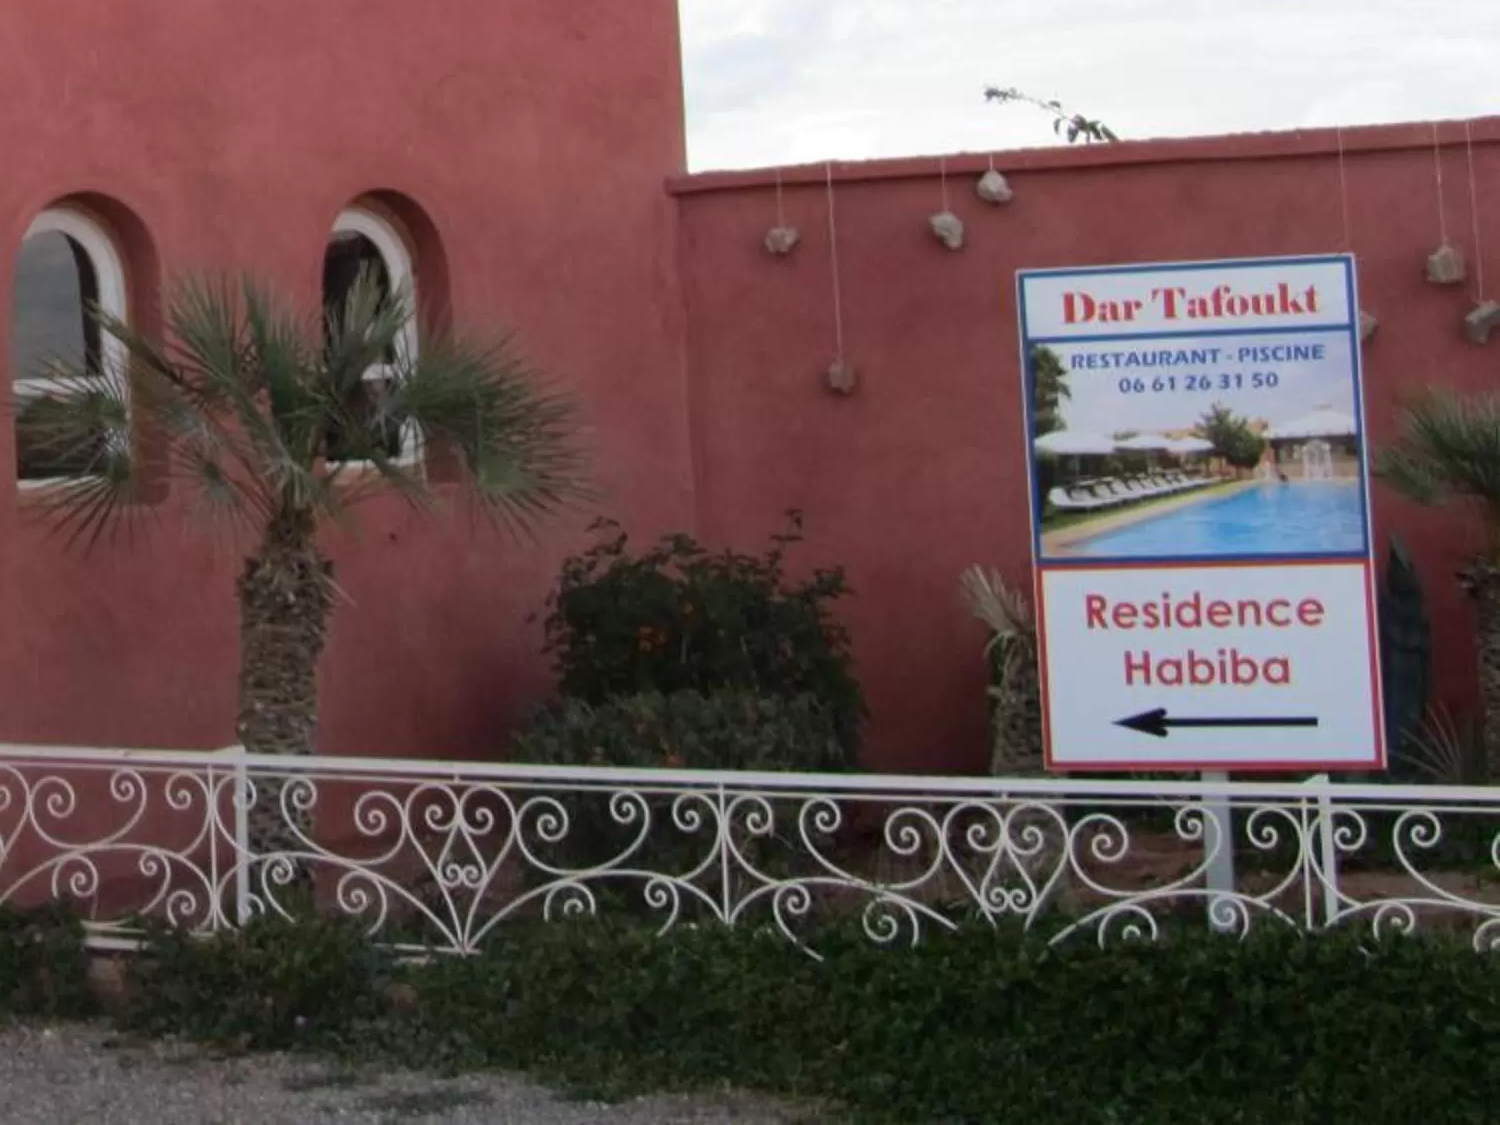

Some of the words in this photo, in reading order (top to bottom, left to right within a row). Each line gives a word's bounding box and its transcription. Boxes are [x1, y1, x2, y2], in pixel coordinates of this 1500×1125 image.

[1062, 291, 1143, 323] Dar
[1152, 282, 1321, 320] Tafoukt
[1071, 348, 1221, 369] RESTAURANT
[1238, 344, 1326, 363] PISCINE
[1119, 377, 1145, 394] 06
[1152, 375, 1176, 392] 61
[1186, 373, 1211, 391] 26
[1218, 372, 1243, 389] 31
[1252, 371, 1279, 388] 50
[1085, 591, 1325, 630] Residence
[1124, 648, 1291, 686] Habiba
